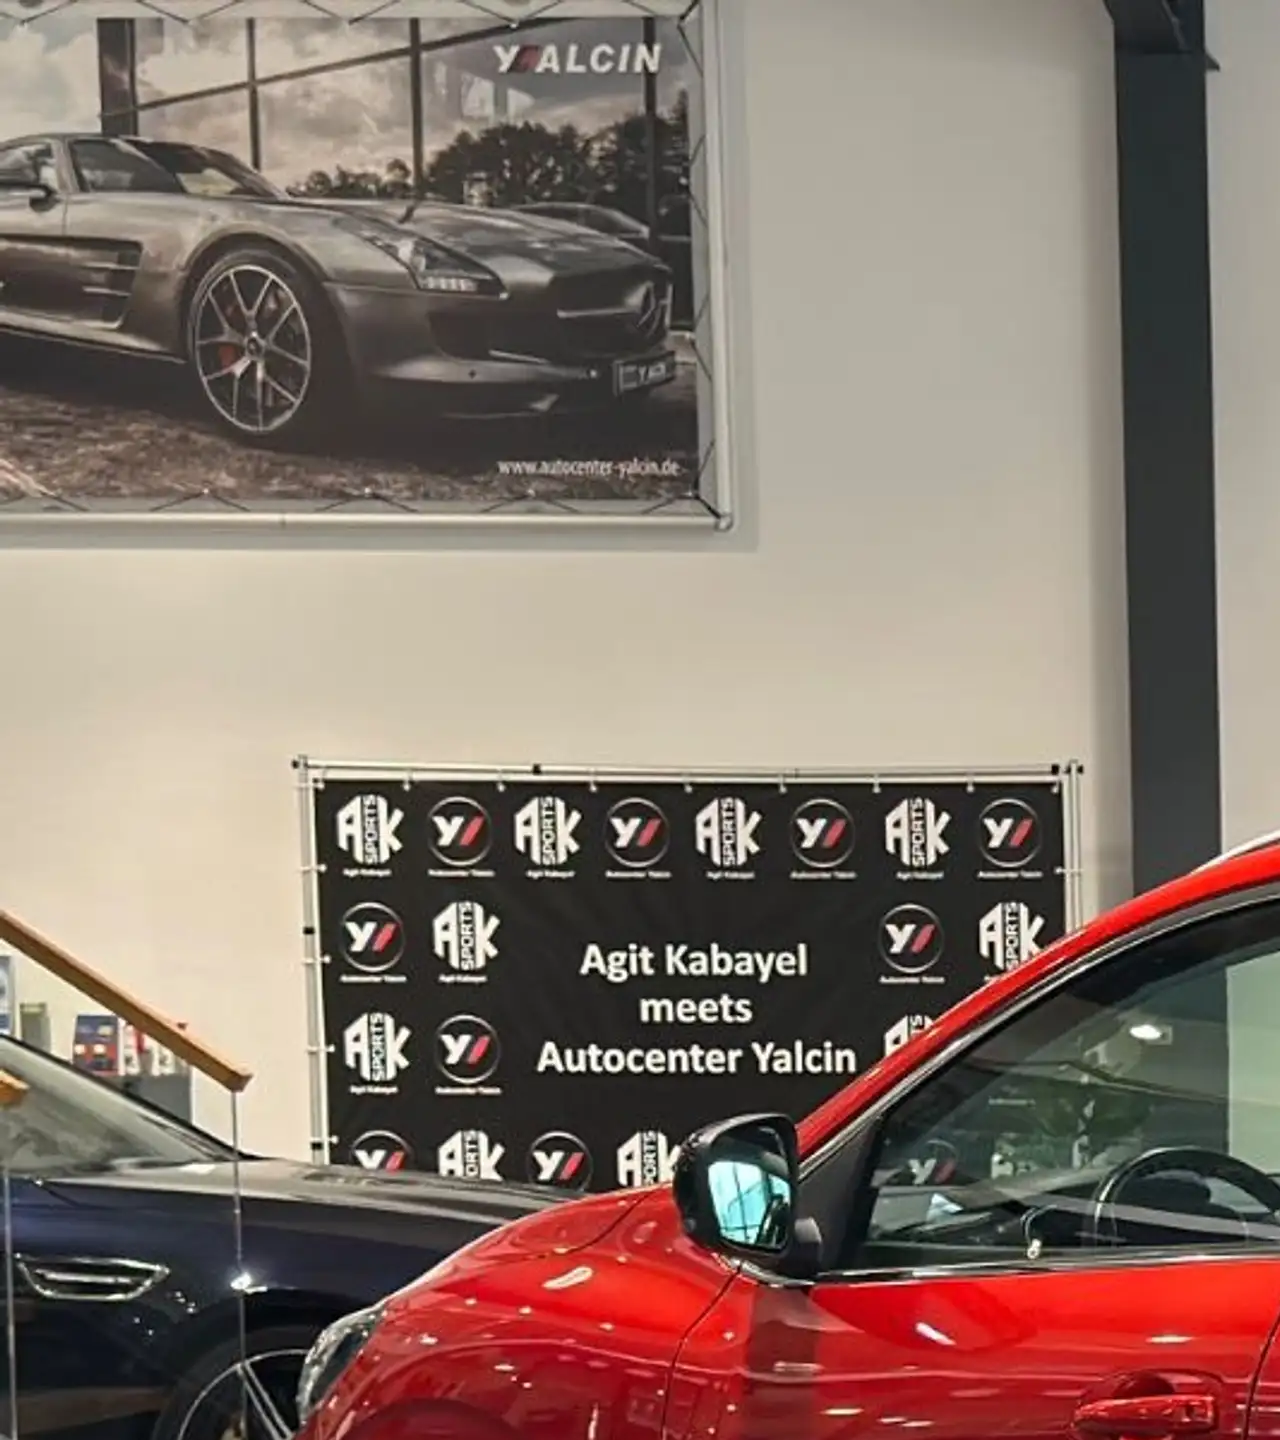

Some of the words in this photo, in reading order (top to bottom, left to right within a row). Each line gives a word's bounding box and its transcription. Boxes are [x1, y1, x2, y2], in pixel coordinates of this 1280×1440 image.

[579, 943, 656, 983] Agit
[665, 943, 808, 983] Kabayel
[640, 993, 752, 1023] meets
[537, 1041, 743, 1074] Autocenter
[752, 1040, 857, 1074] Yalcin
